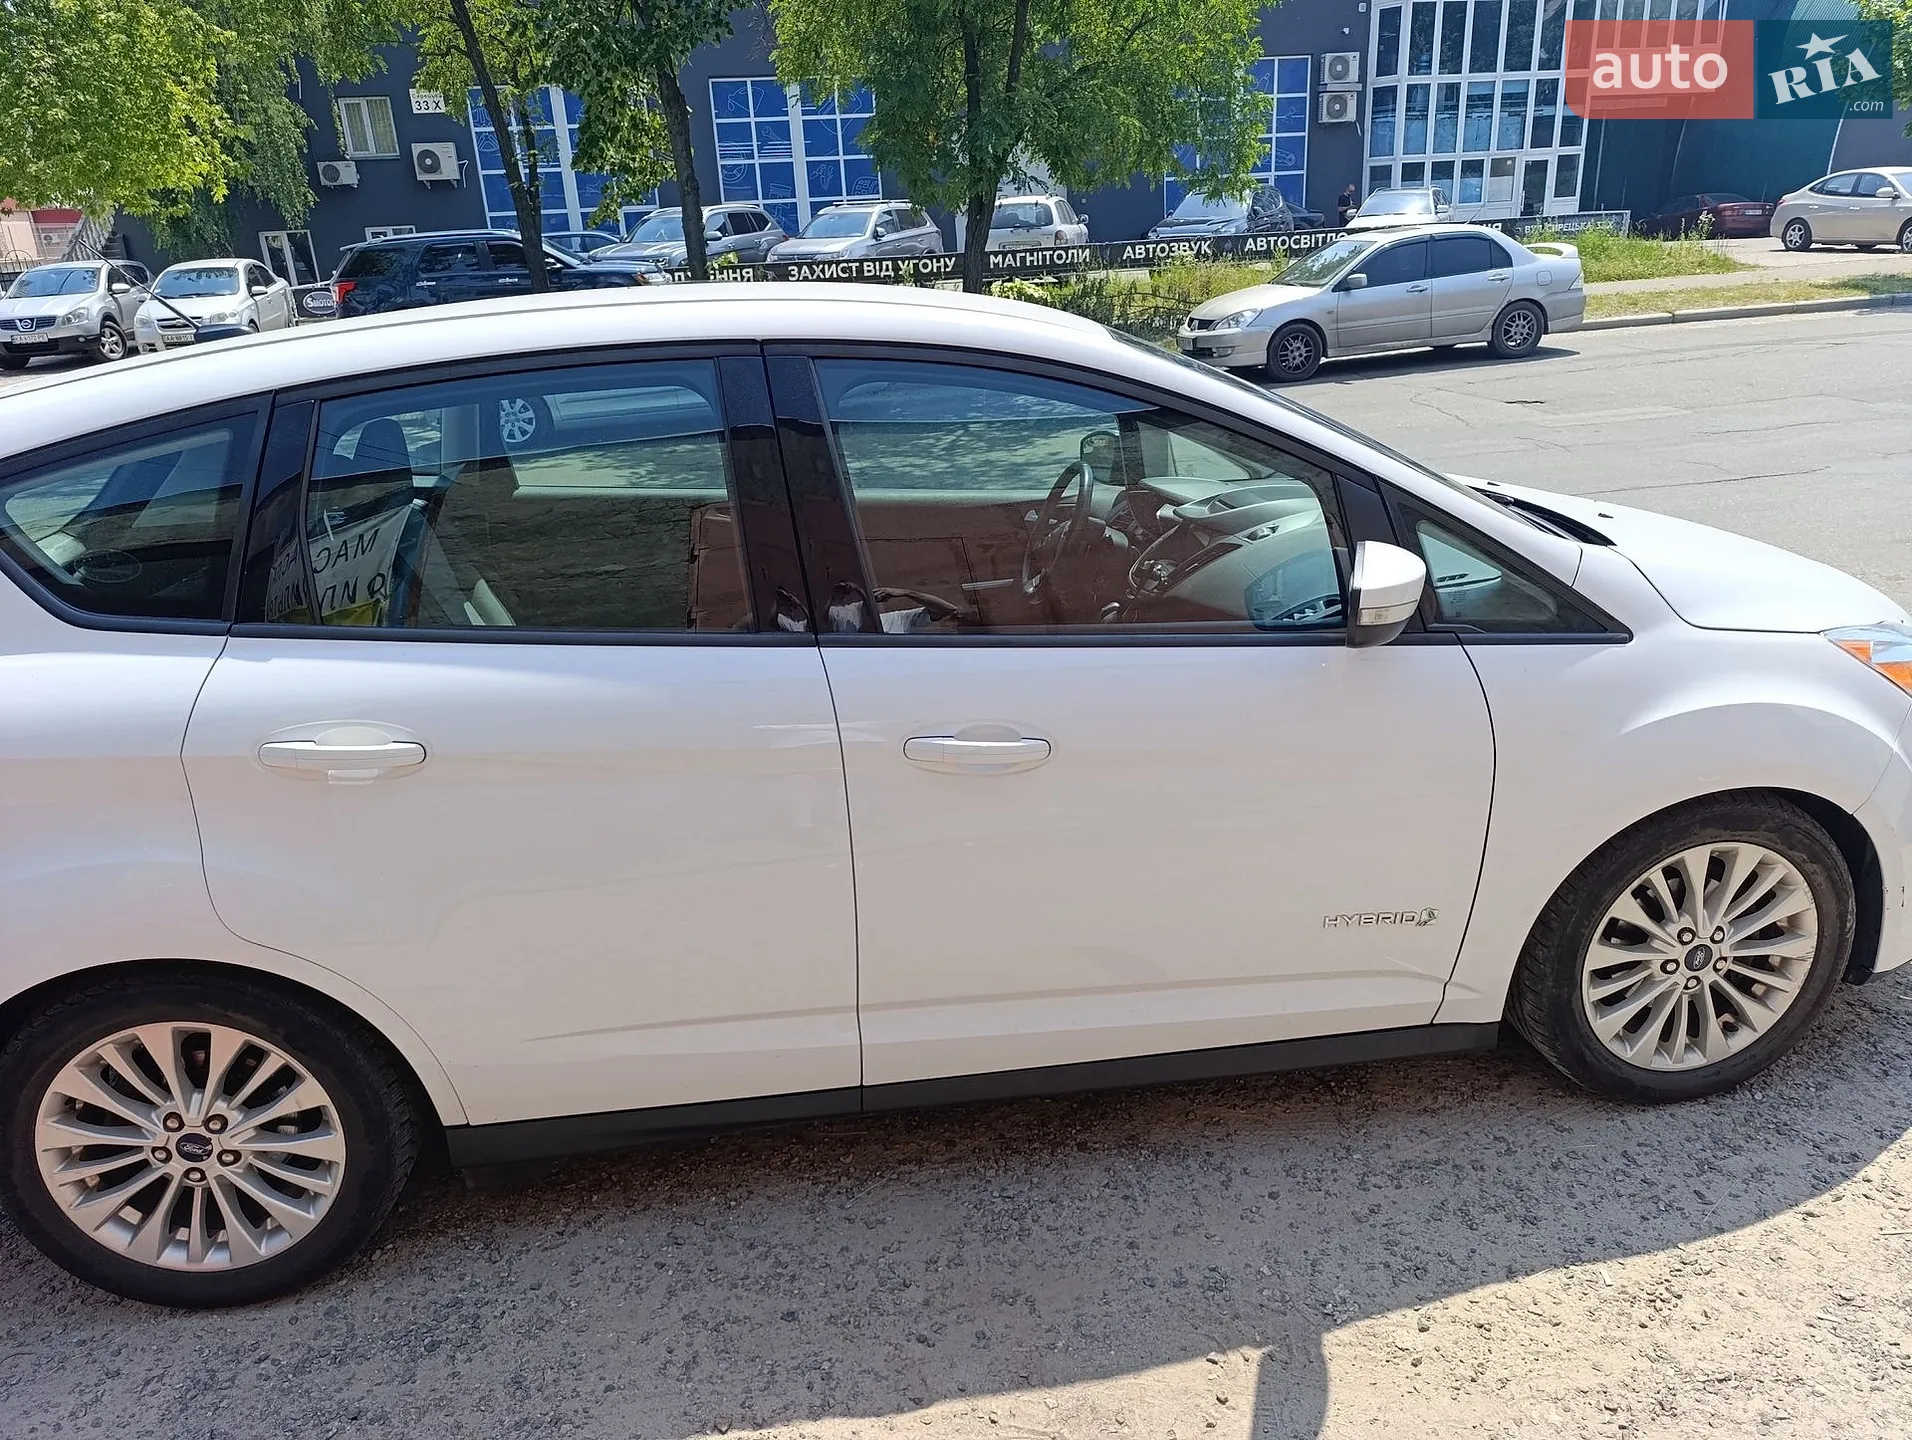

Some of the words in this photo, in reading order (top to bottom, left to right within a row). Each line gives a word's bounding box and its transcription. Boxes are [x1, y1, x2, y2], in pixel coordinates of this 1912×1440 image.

[415, 100, 430, 111] 33
[990, 249, 1090, 269] МАГНІТОЛИ
[1122, 240, 1212, 260] АВТОЗВУК
[788, 262, 859, 281] ЗАХИСТ
[863, 261, 894, 278] ВІД
[899, 257, 956, 275] УГОНУ
[1323, 911, 1418, 928] HYBRID
